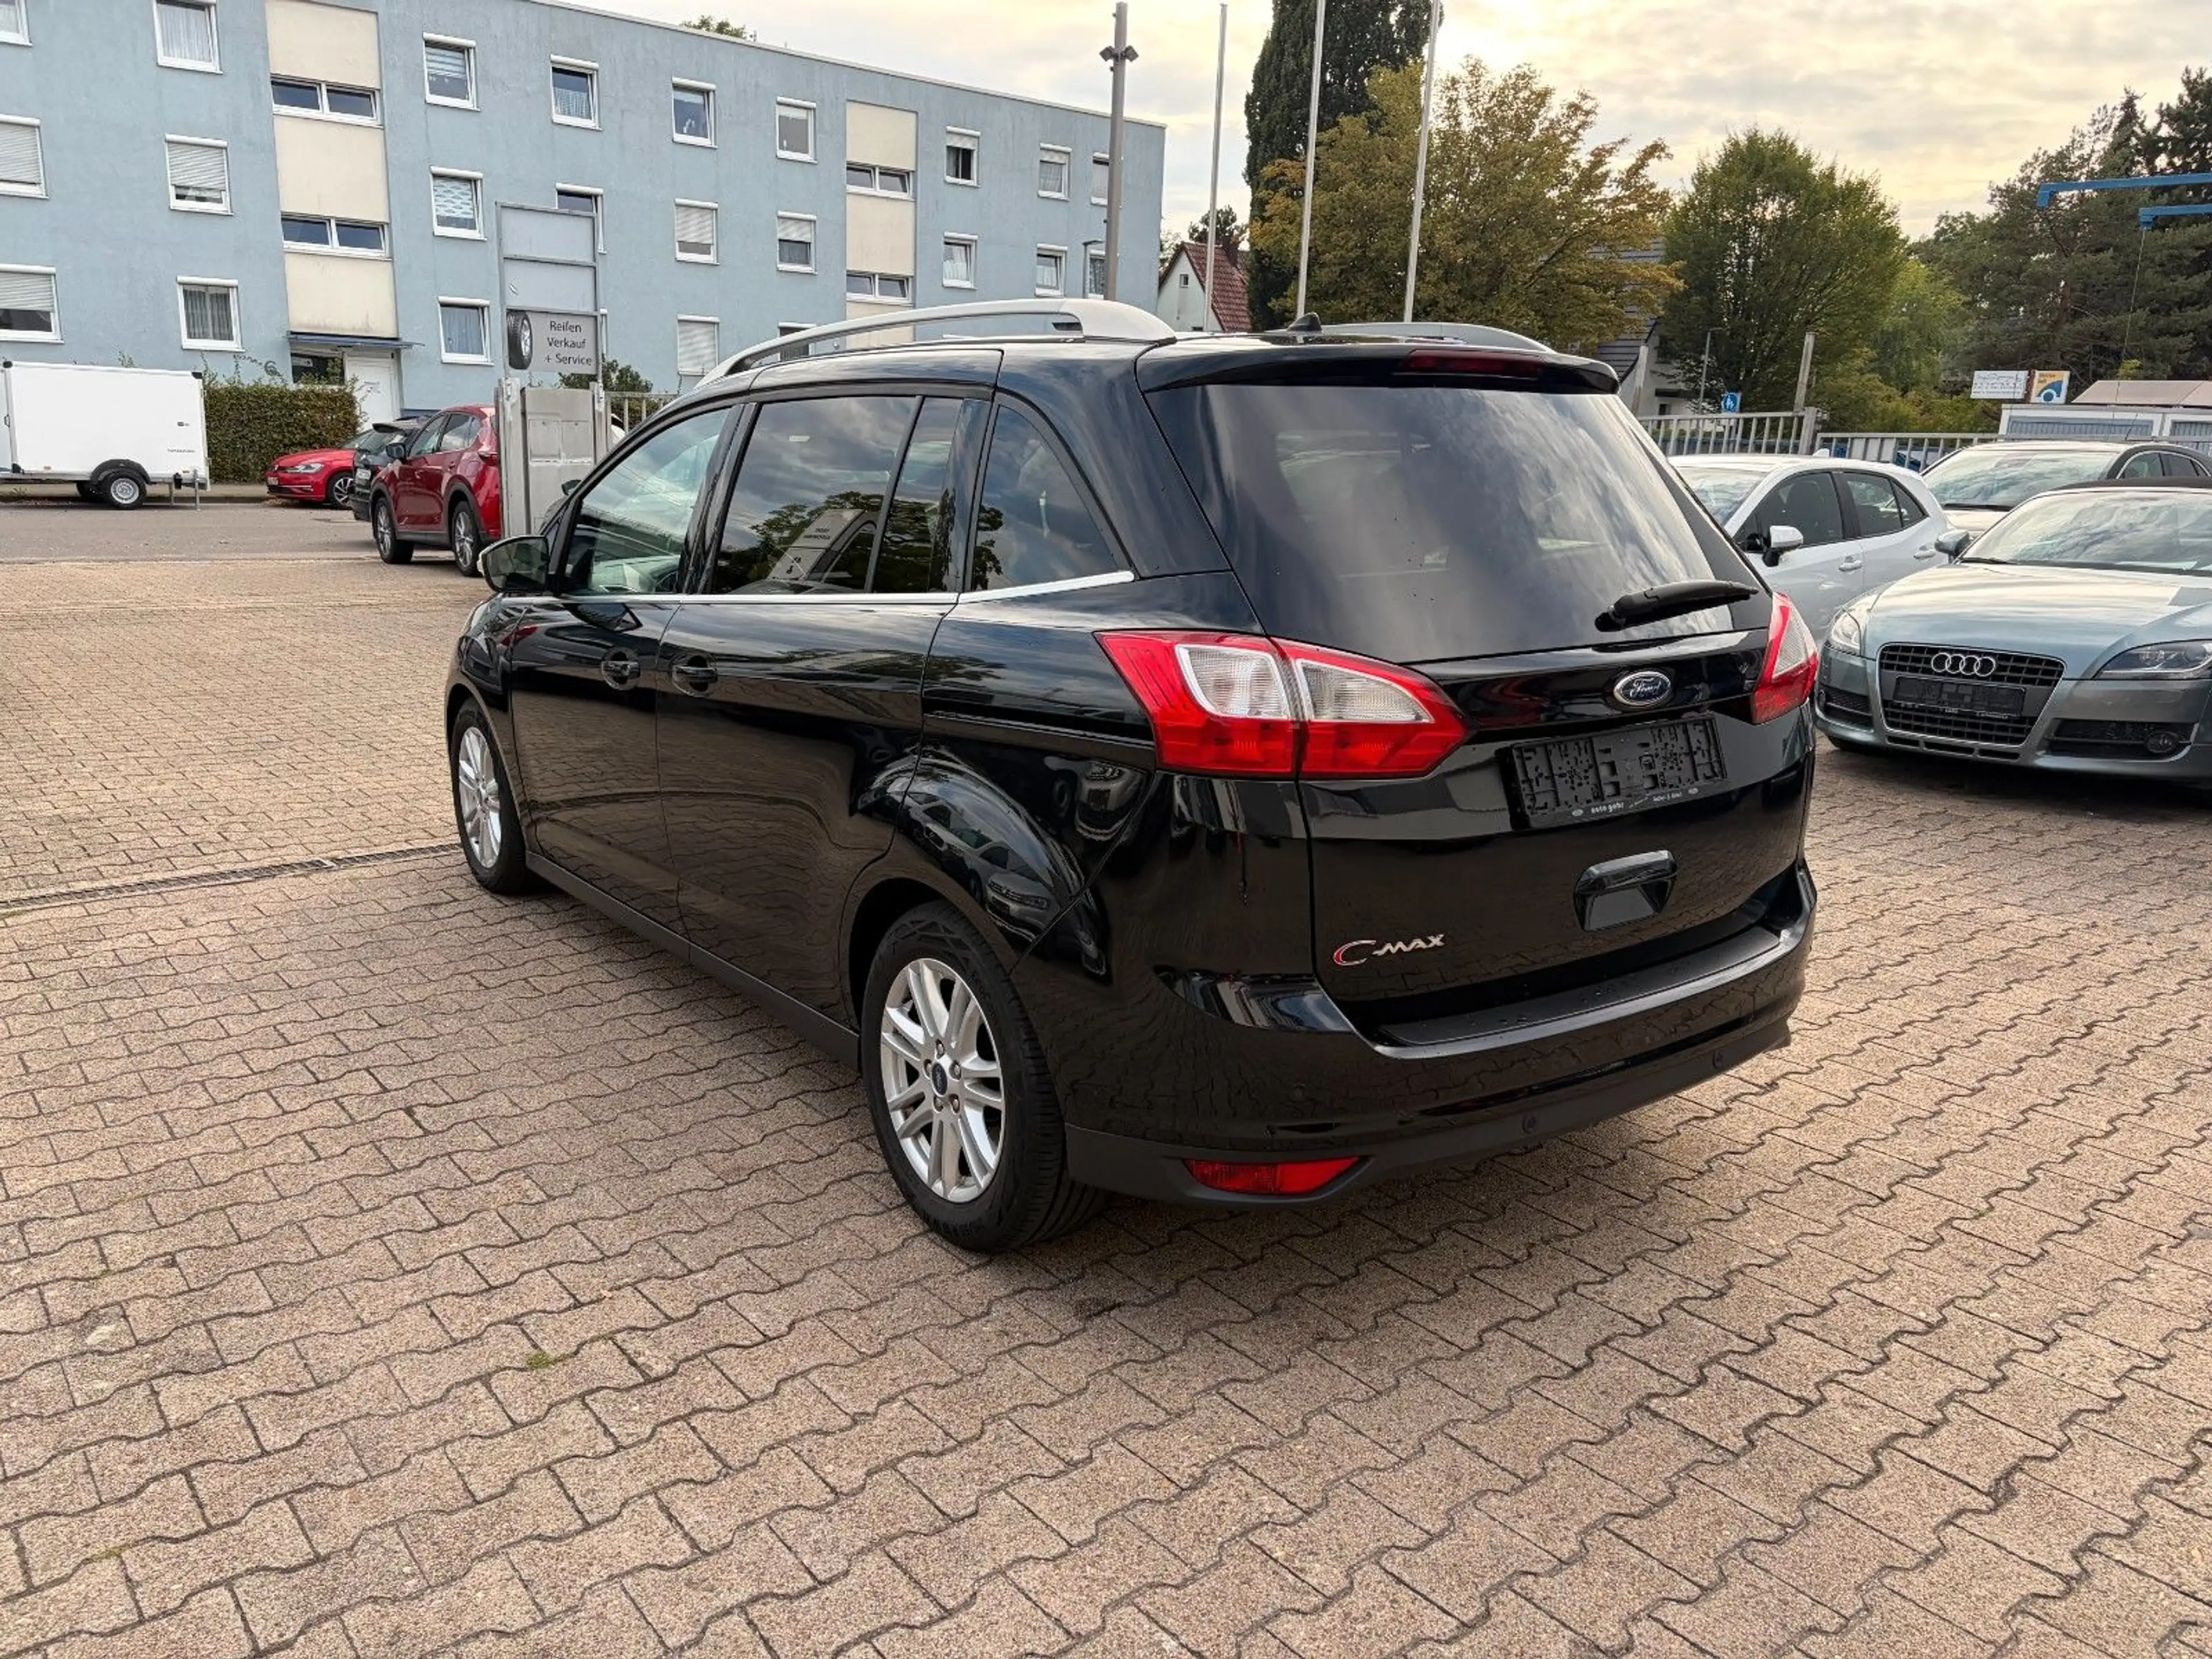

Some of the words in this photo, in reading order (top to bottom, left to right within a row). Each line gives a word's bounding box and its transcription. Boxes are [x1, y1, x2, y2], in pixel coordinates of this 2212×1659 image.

[550, 320, 582, 332] Reifen
[547, 338, 586, 349] Verkauf
[544, 355, 551, 363] +
[555, 353, 592, 366] Service
[1629, 677, 1662, 698] Ford
